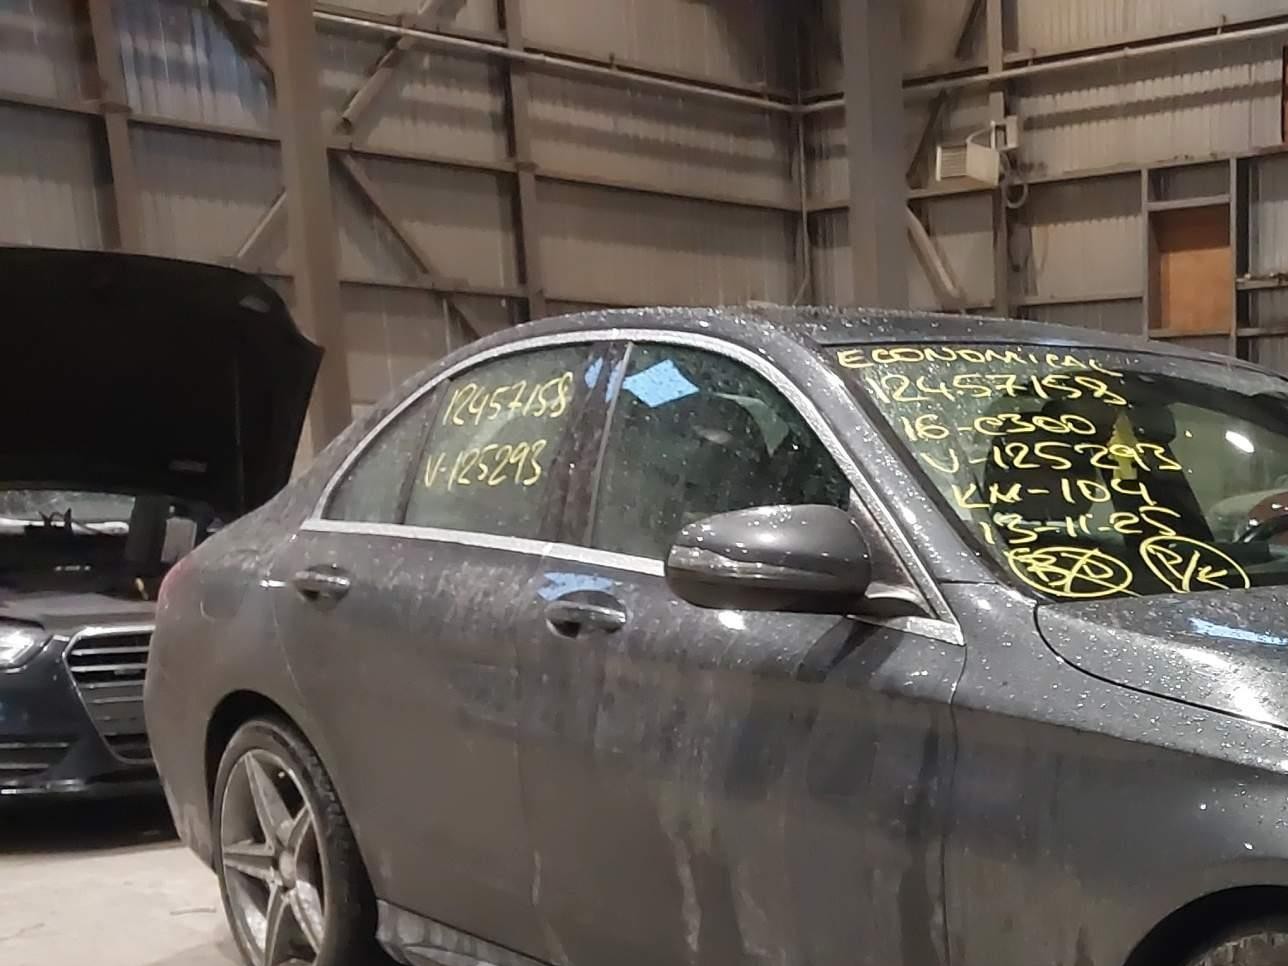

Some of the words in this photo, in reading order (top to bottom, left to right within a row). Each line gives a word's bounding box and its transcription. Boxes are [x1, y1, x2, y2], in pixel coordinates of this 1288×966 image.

[838, 347, 1123, 377] ECONOMICAL
[443, 371, 574, 426] 12457158
[866, 373, 1127, 405] 12457158
[424, 439, 547, 491] V-125293
[921, 441, 1182, 474] V-125293
[979, 506, 1181, 545] 13-11-25
